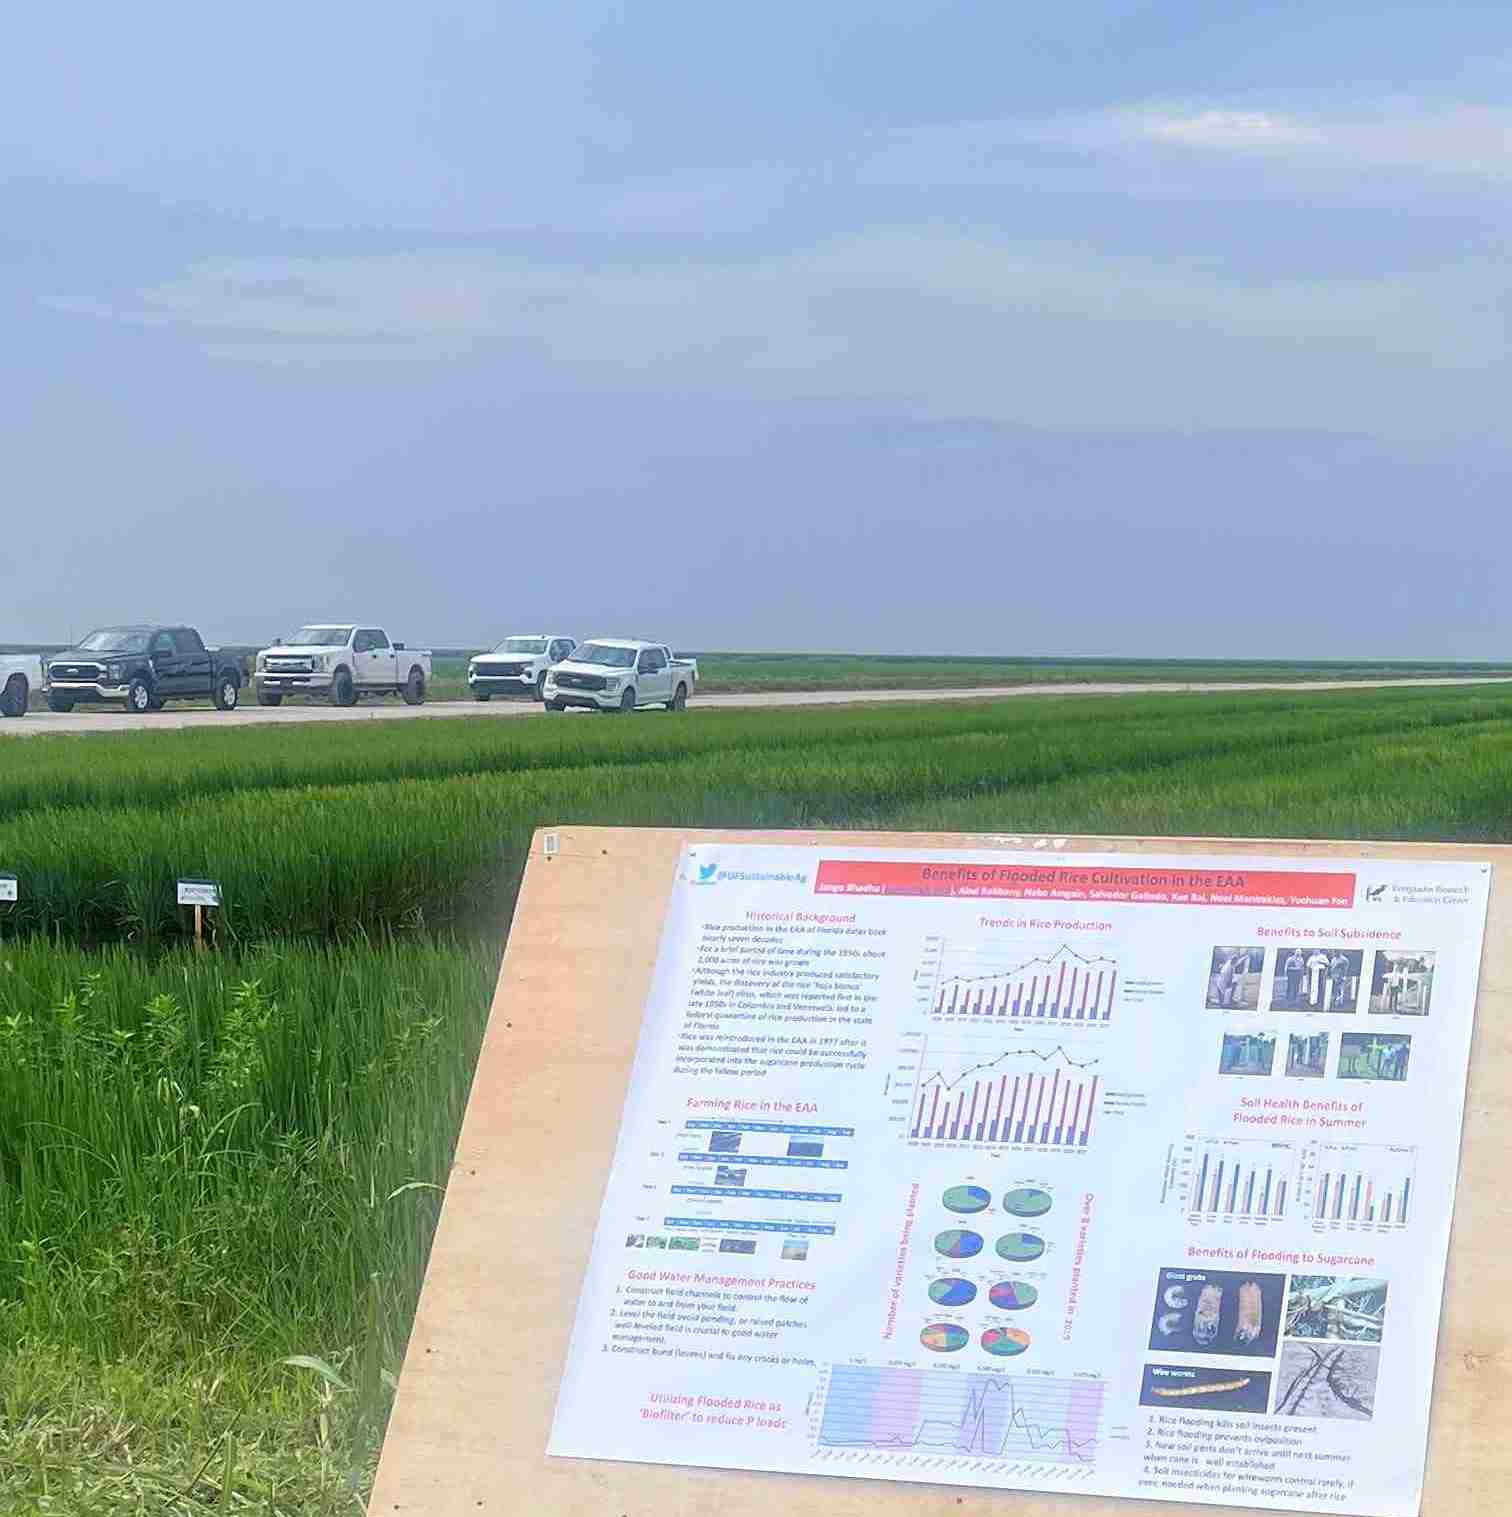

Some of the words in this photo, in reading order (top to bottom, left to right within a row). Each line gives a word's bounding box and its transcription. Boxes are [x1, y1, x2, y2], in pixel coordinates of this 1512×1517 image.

[922, 867, 977, 881] Benefits
[982, 869, 998, 881] of
[1001, 870, 1056, 883] Flooded
[1060, 872, 1089, 885] Rice
[1092, 871, 1167, 886] Cultivation
[1172, 874, 1186, 887] in
[1190, 874, 1212, 887] the
[1216, 875, 1245, 888] EAA
[746, 911, 793, 921] Historical
[795, 911, 856, 924] Background
[1029, 919, 1052, 929] Rice
[1055, 919, 1112, 930] Production
[1257, 926, 1301, 938] Benefits
[1303, 927, 1315, 938] to
[1317, 927, 1340, 938] Soil
[1340, 928, 1401, 940] Subsidence
[687, 1098, 732, 1111] Farming
[734, 1099, 758, 1110] Rice
[760, 1100, 770, 1110] in
[774, 1100, 793, 1111] the
[795, 1102, 818, 1113] EAA
[1240, 1096, 1261, 1109] Soil
[1264, 1098, 1300, 1110] Health
[1303, 1100, 1348, 1112] Benefits
[1350, 1101, 1363, 1112] of
[1233, 1112, 1277, 1124] Flooded
[1280, 1114, 1304, 1126] Rice
[1319, 1116, 1367, 1128] Summer
[1188, 1246, 1234, 1259] Benefits
[1236, 1249, 1250, 1260] of
[1251, 1251, 1299, 1265] Flooding
[1301, 1253, 1314, 1264] to
[1317, 1254, 1375, 1267] Sugarcane
[628, 1269, 656, 1281] Good
[659, 1271, 691, 1283] Water
[693, 1273, 766, 1287] Management
[767, 1278, 817, 1290] Practices
[650, 1392, 694, 1407] Utilizing
[697, 1395, 742, 1409] Flooded
[744, 1399, 767, 1411] Rice
[693, 1412, 704, 1422] to
[706, 1414, 745, 1425] reduce
